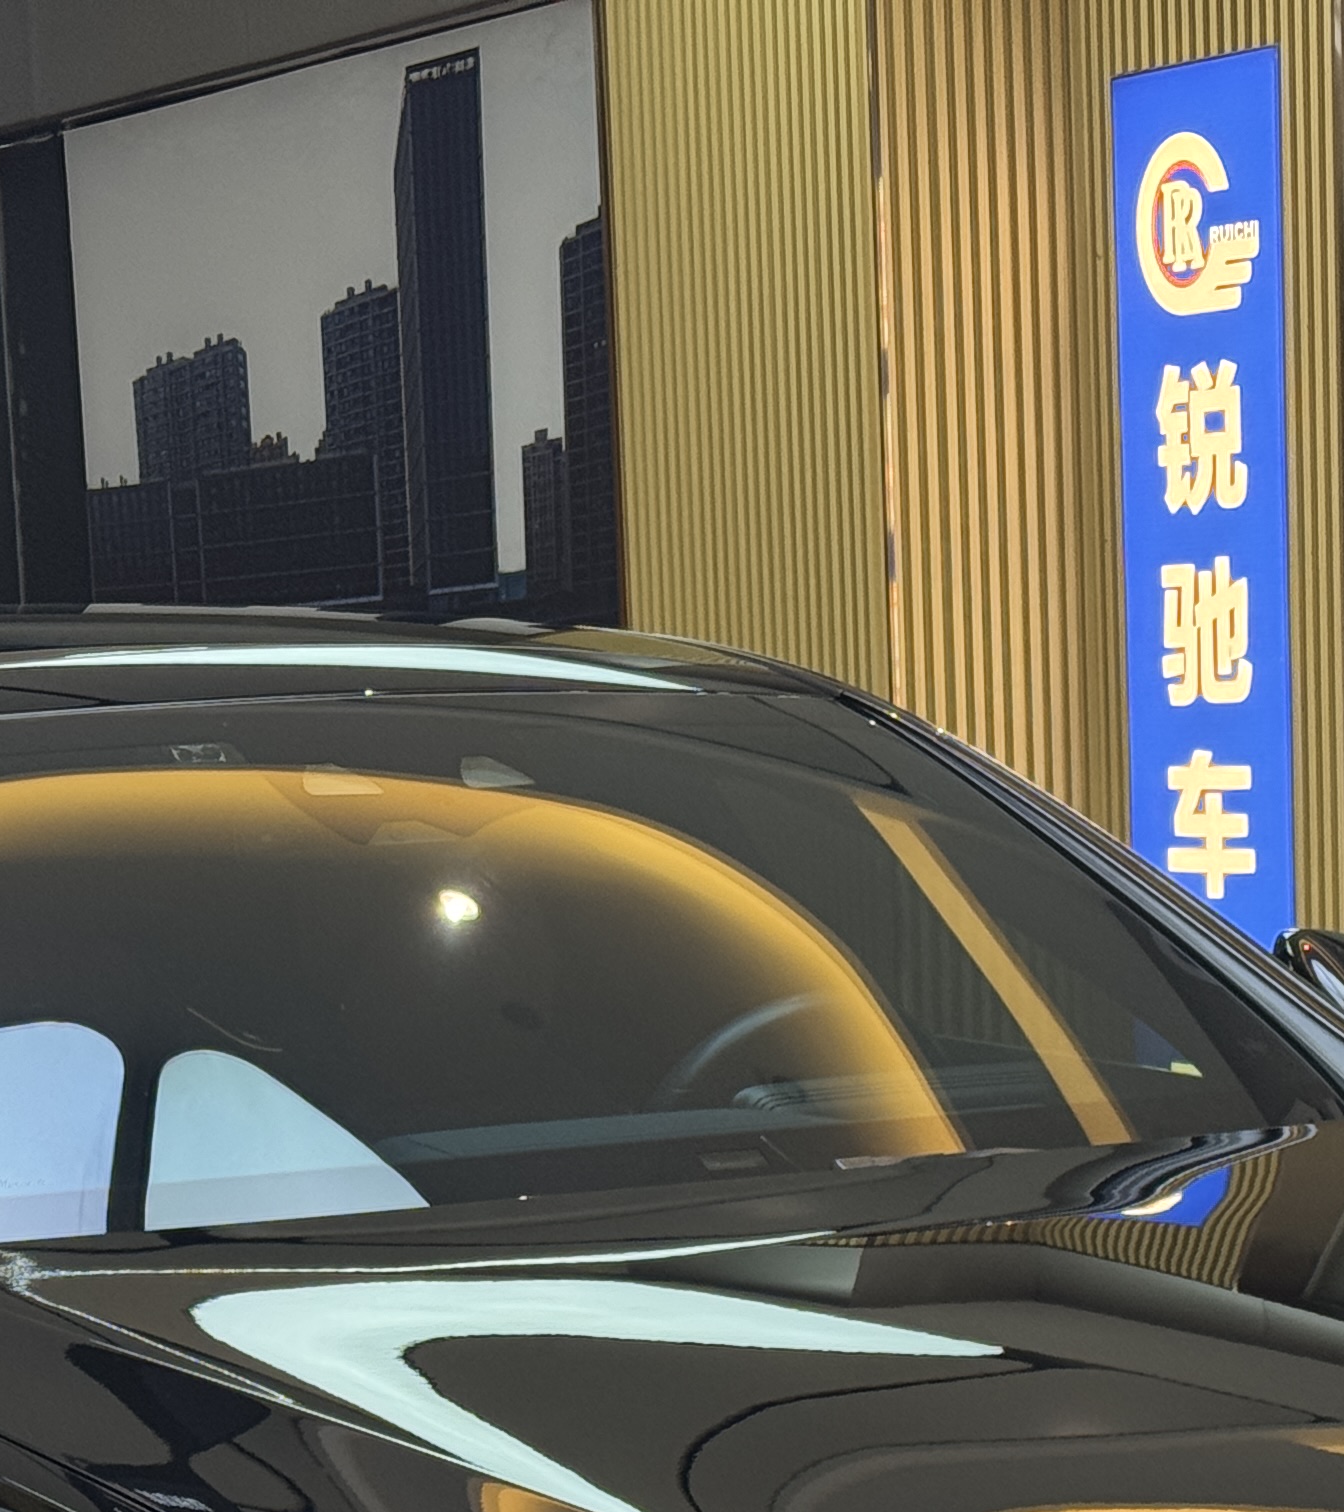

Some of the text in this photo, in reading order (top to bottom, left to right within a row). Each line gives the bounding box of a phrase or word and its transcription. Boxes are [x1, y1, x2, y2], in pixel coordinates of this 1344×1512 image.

[1209, 219, 1260, 245] RUICHI
[1156, 359, 1257, 900] 锐驰车
